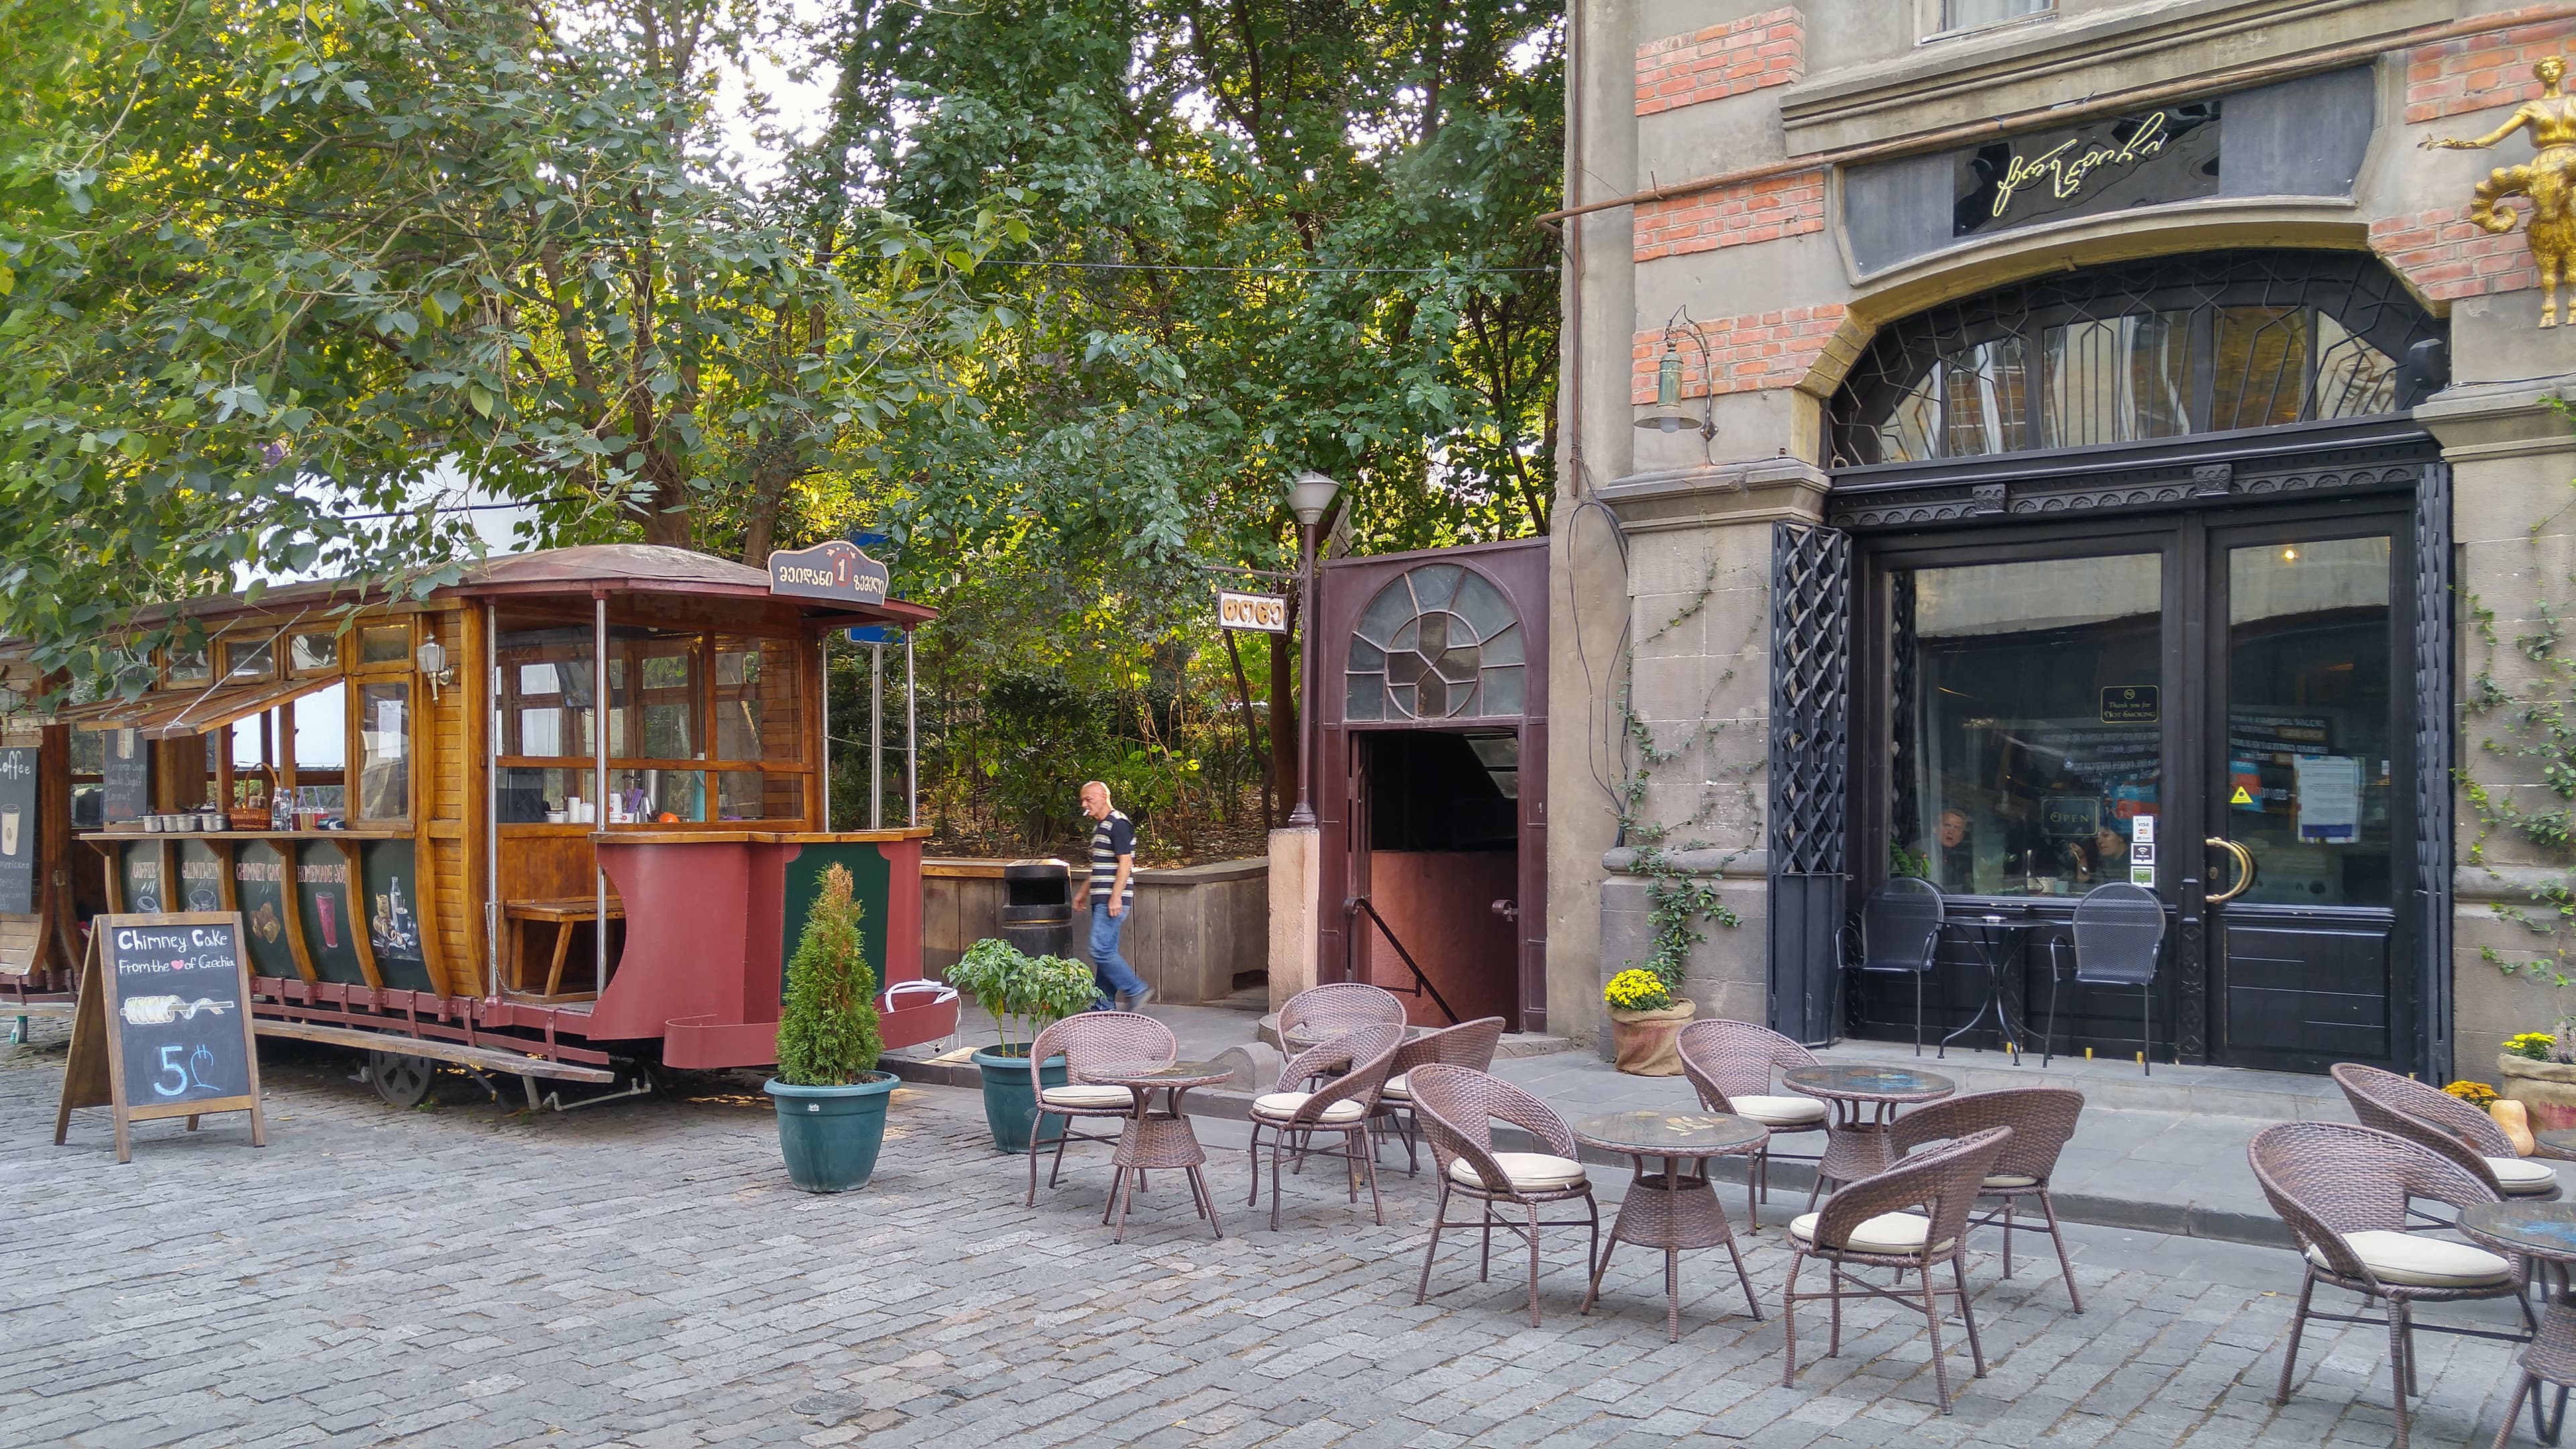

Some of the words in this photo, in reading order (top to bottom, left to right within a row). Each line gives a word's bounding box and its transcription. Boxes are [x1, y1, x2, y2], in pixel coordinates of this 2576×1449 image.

[779, 566, 834, 587] მეიდანი
[853, 574, 884, 595] ზემელი
[1222, 598, 1285, 625] თონე
[0, 750, 30, 780] offee
[236, 863, 266, 881] CHIMNEY
[297, 864, 333, 883] HOMEMADE
[118, 930, 188, 953] Chimney
[184, 957, 197, 971] of
[198, 954, 235, 969] Czechia
